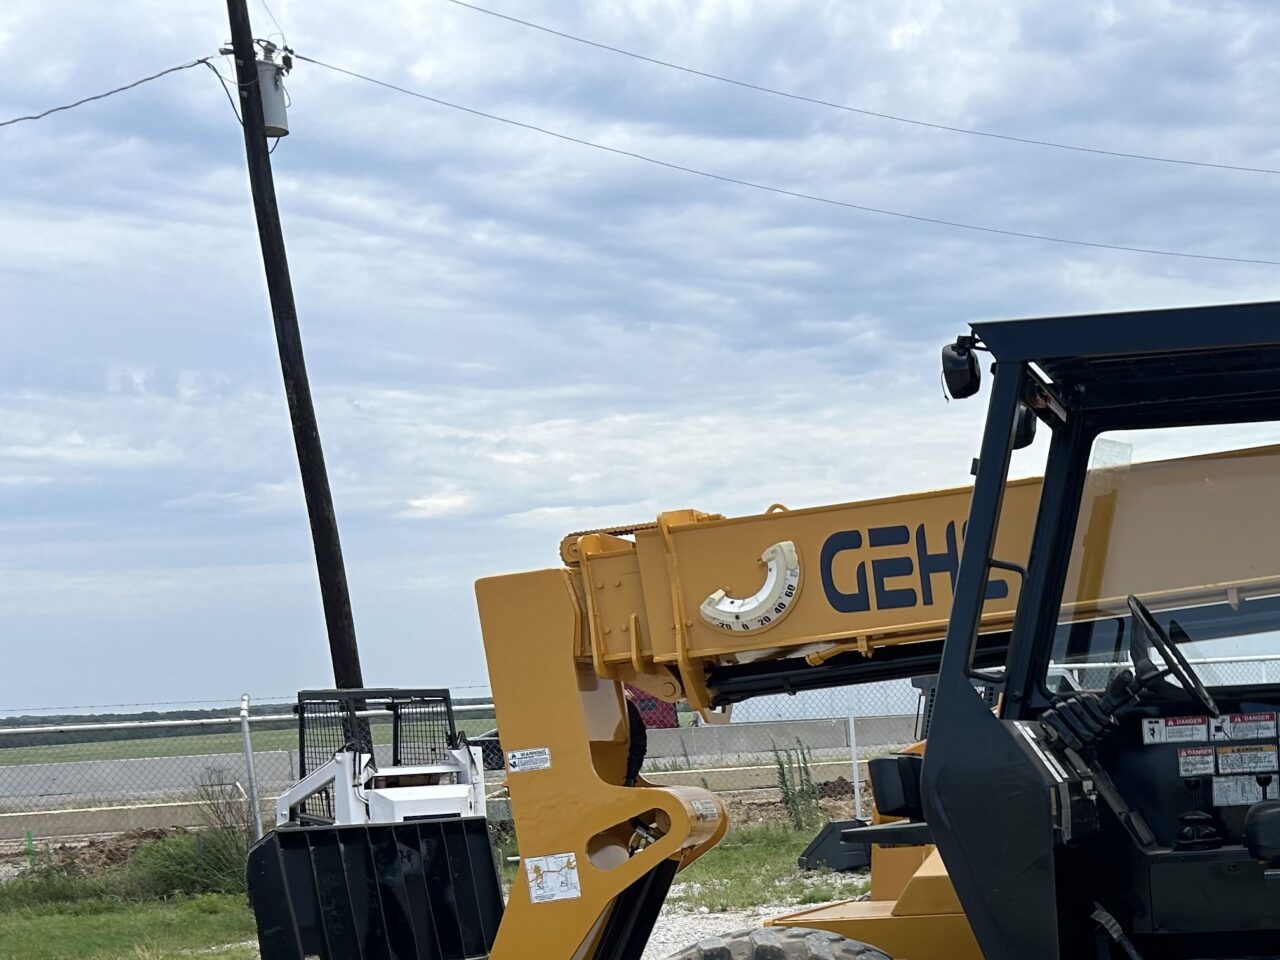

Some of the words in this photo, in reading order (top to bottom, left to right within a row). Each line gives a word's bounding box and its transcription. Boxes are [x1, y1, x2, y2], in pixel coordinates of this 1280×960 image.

[757, 615, 771, 626] 20
[774, 602, 786, 614] 40
[784, 584, 796, 598] 60
[1187, 748, 1212, 756] DANGER
